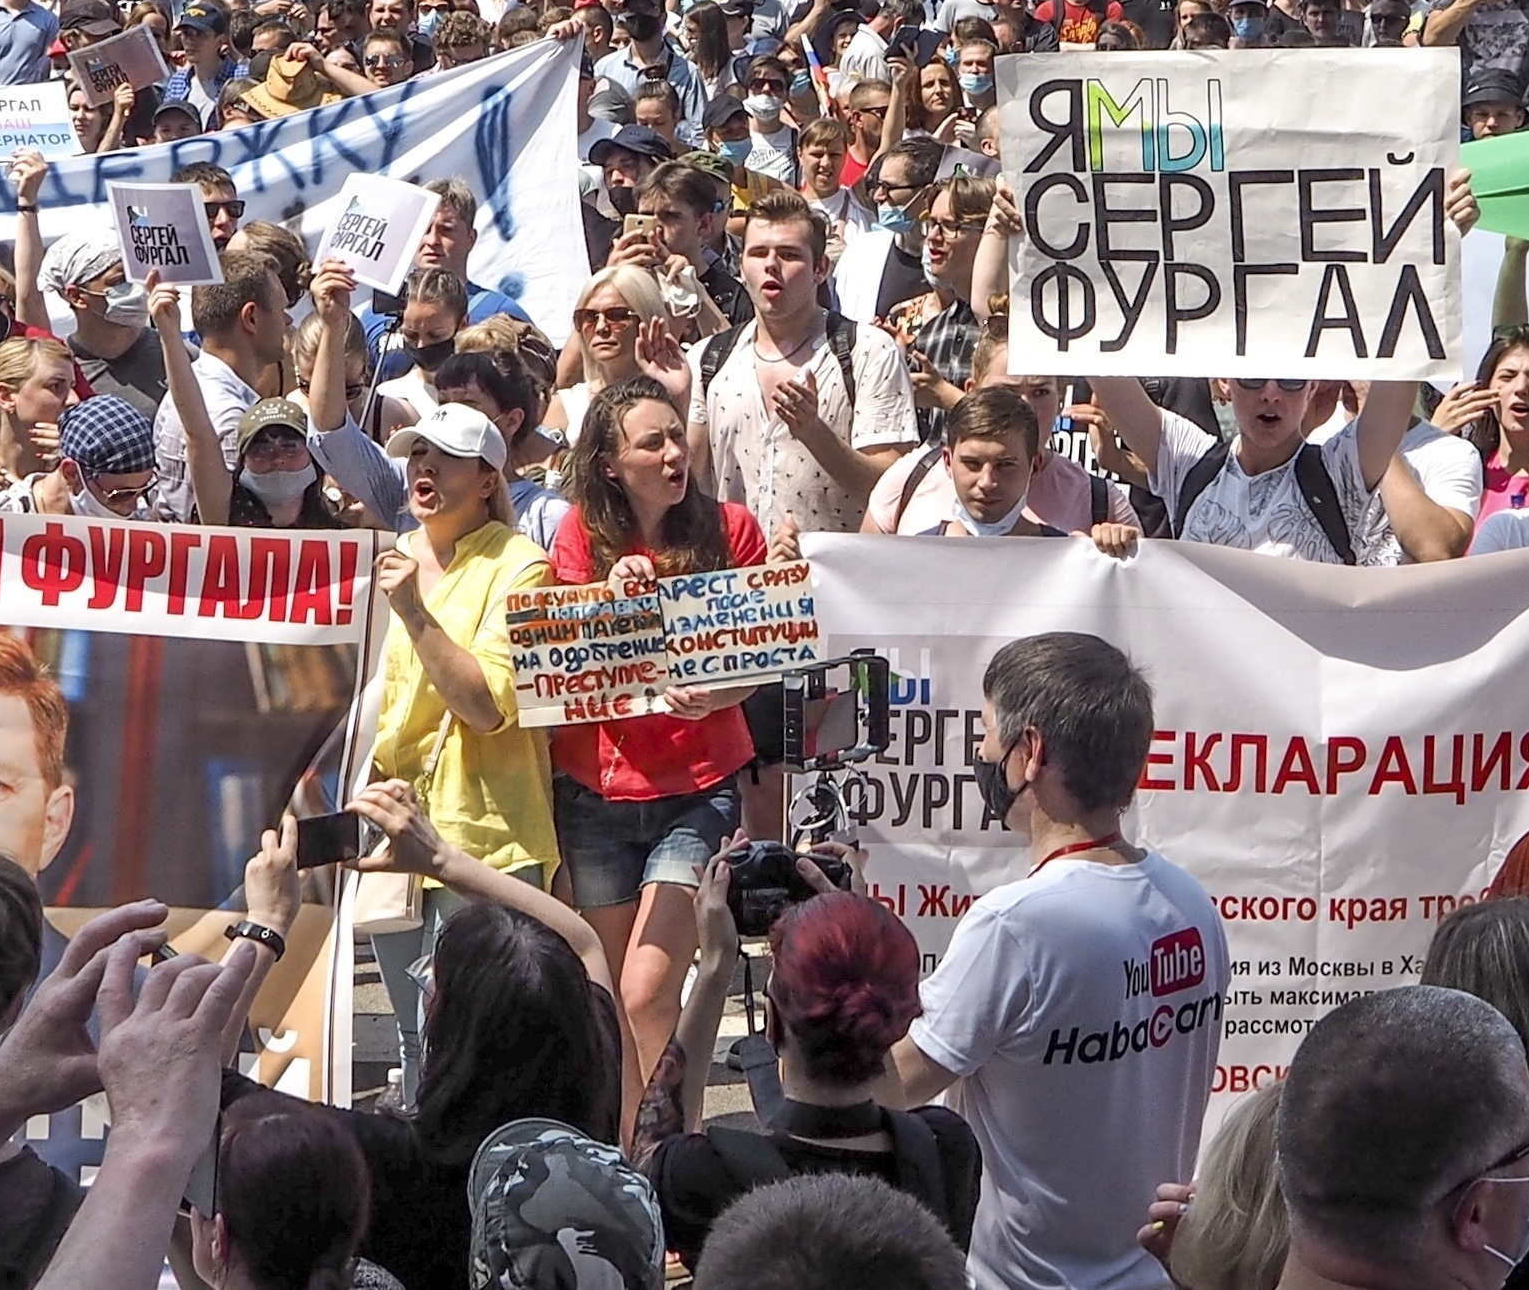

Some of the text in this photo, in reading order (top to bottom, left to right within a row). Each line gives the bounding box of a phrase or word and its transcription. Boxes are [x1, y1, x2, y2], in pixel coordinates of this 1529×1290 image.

[1023, 78, 1225, 174] ЯМЫ
[1025, 152, 1446, 265] СЕРГЕЙ
[131, 223, 179, 246] СЕРГЕЙ
[337, 212, 388, 240] СЕРГЕЙ
[134, 245, 190, 266] ФУРГАЛ
[330, 231, 386, 261] ФУРГАЛ
[1030, 260, 1447, 360] ФУРГАЛ
[20, 522, 359, 626] ФУРГАЛА!
[1210, 895, 1317, 921] ского
[1329, 897, 1407, 929] края
[1123, 942, 1203, 1000] YouTube
[1258, 962, 1281, 975] из
[1289, 957, 1374, 976] Москвы
[1382, 962, 1393, 975] в
[1043, 991, 1222, 1065] HabaCam
[1225, 1019, 1321, 1038] рассмот
